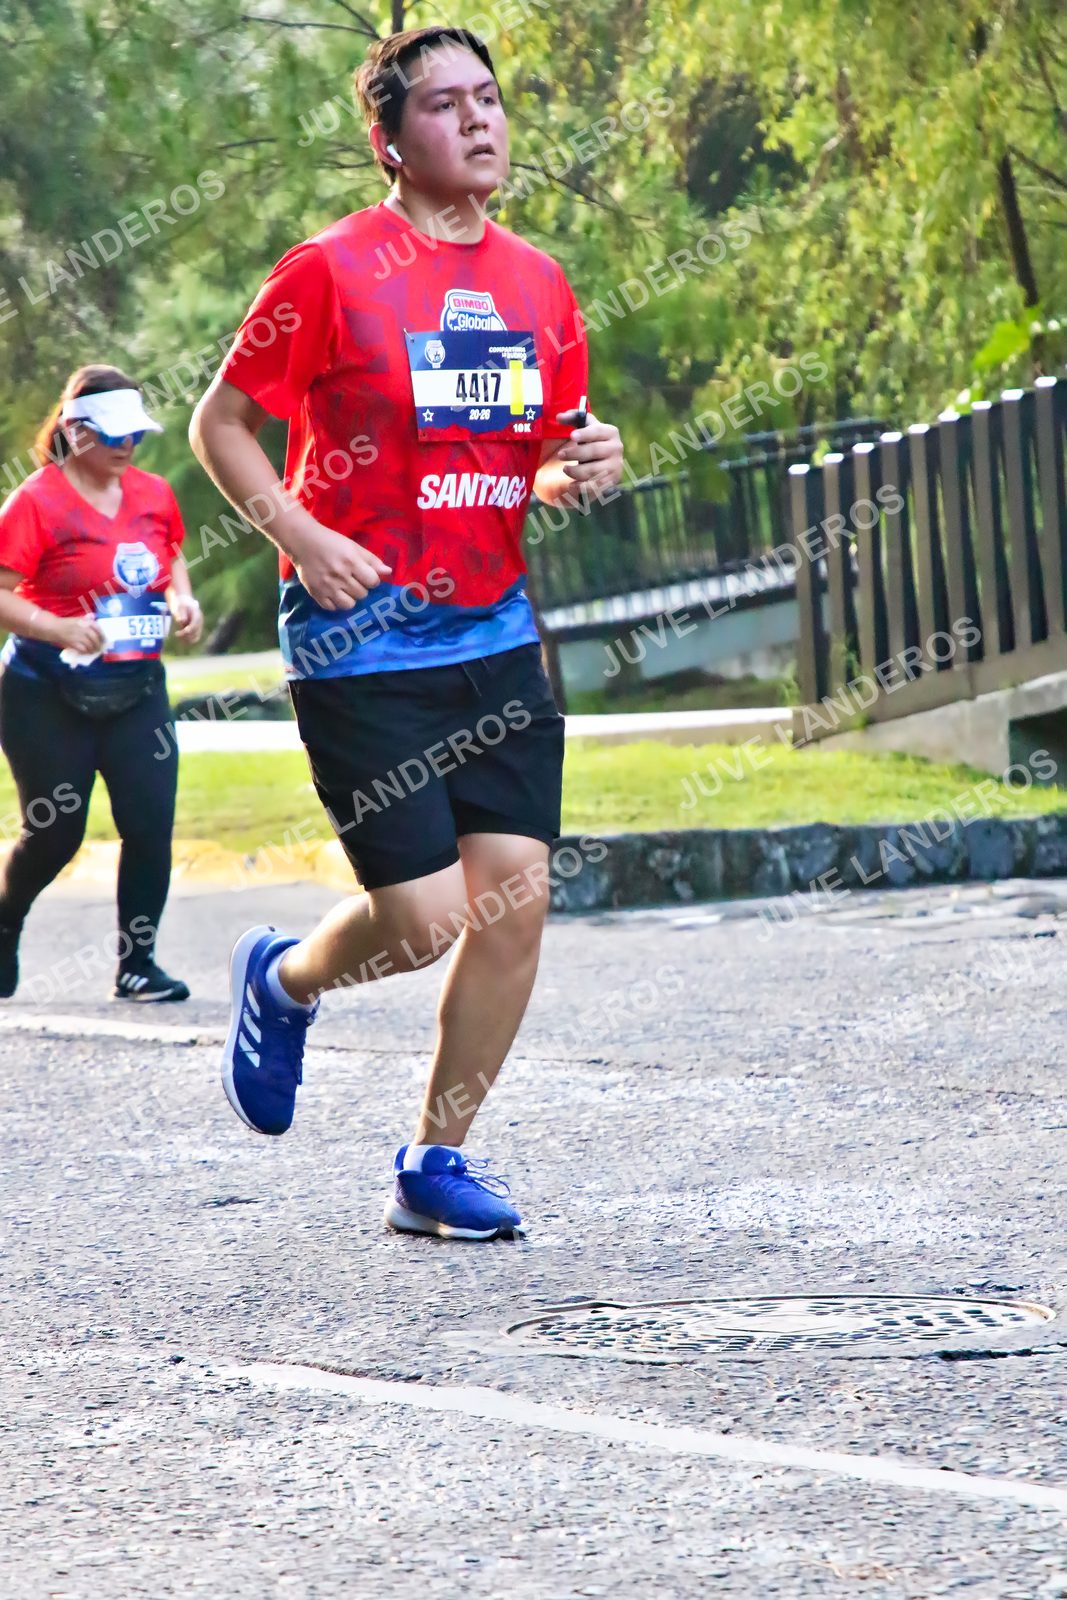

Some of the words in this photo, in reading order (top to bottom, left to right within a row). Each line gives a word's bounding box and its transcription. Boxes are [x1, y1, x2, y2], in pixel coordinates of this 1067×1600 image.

[453, 298, 489, 310] BIMBO
[458, 313, 490, 330] Global
[456, 372, 501, 402] 4417
[513, 423, 532, 433] 10K
